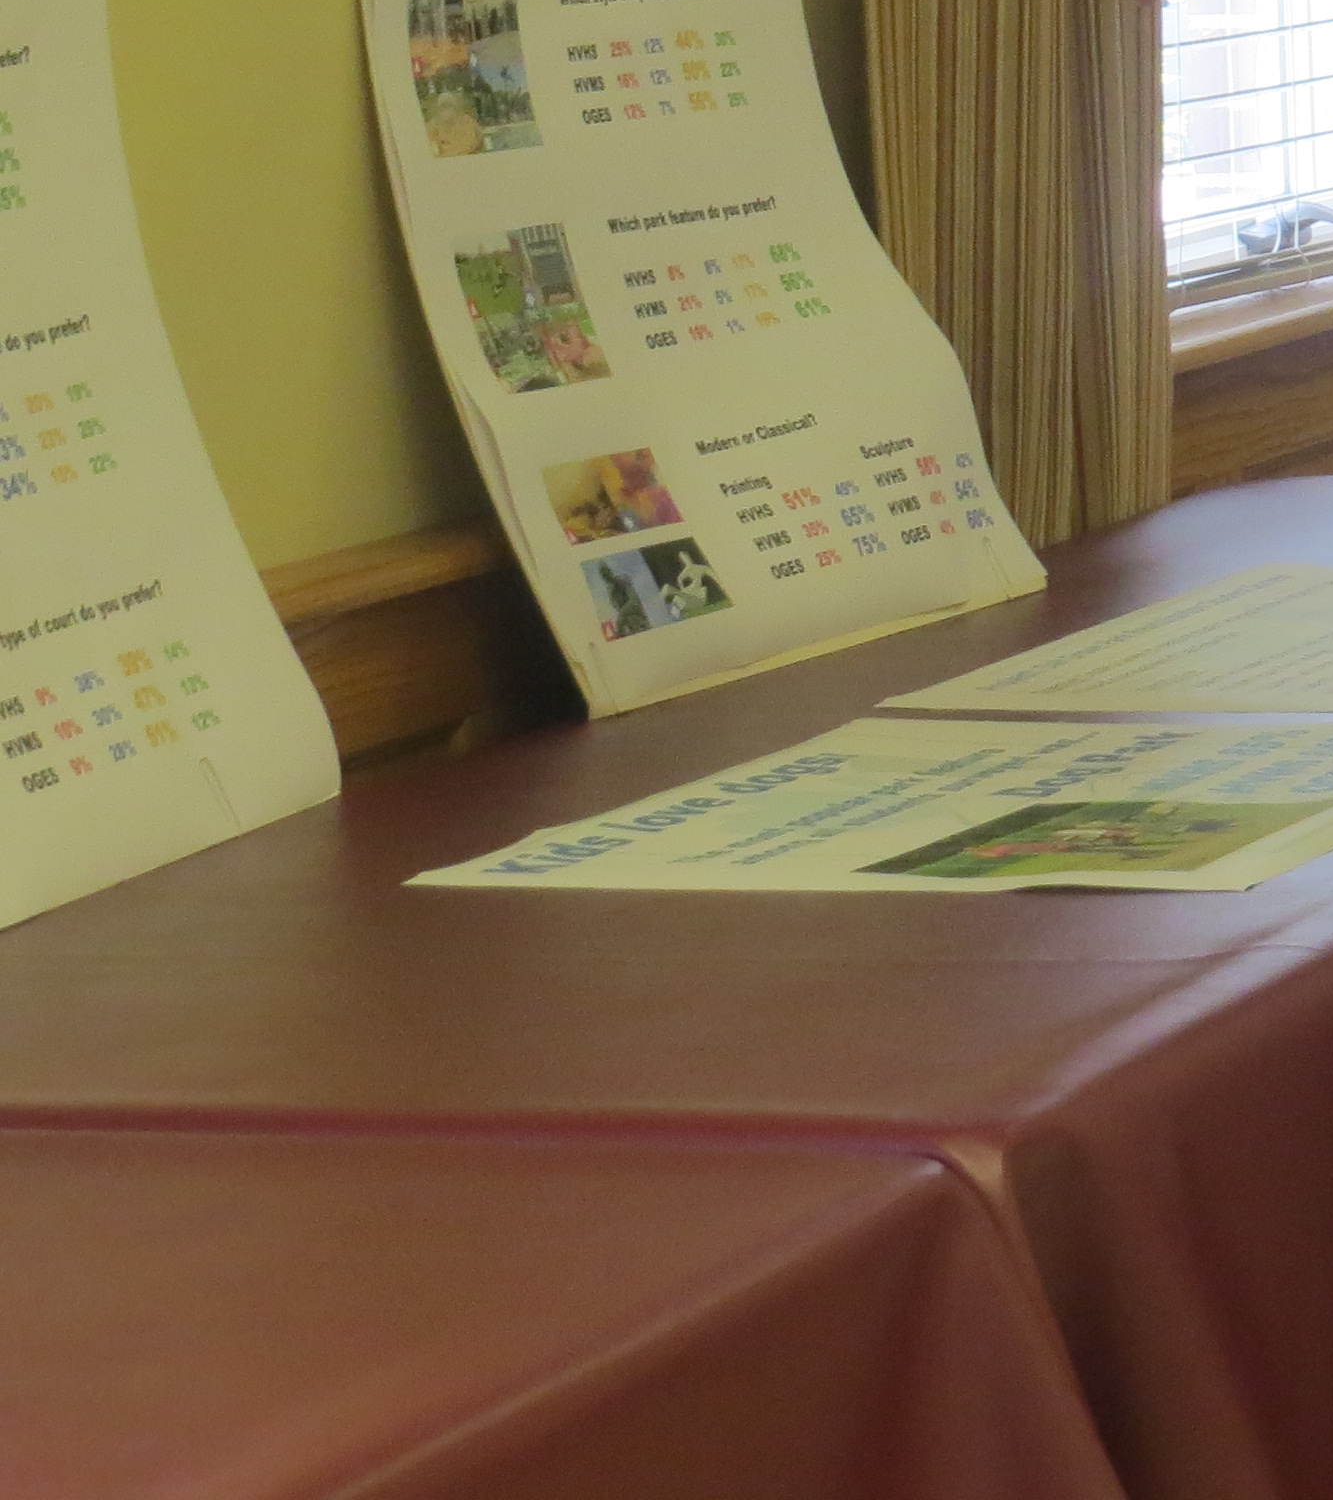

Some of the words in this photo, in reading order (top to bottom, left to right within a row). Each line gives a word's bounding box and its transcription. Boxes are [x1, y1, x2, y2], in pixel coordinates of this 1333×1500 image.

[566, 43, 598, 62] HVHS
[573, 75, 606, 93] HVMS
[581, 106, 614, 125] OGES
[606, 215, 643, 234] Which
[643, 214, 668, 232] park
[668, 207, 707, 227] feature
[707, 204, 721, 220] do
[722, 203, 741, 221] you
[742, 195, 777, 217] prefer?
[623, 269, 657, 288] HVHS
[633, 300, 668, 320] HVMS
[5, 333, 21, 351] do
[22, 329, 47, 351] you
[48, 313, 91, 345] prefer?
[645, 329, 679, 350] OGES
[694, 434, 739, 457] Modern
[741, 430, 756, 446] or
[755, 412, 819, 442] Classical?
[859, 436, 914, 460] Sculpture
[719, 473, 774, 498] Painting
[873, 467, 909, 488] HVHS
[736, 502, 774, 525] HVHS
[779, 486, 822, 511] 51%
[887, 494, 922, 517] HVMS
[753, 529, 792, 553] HVMS
[839, 503, 876, 528] 65%
[900, 524, 932, 545] OGES
[769, 557, 805, 580] OGES
[851, 531, 888, 556] 75%
[28, 618, 42, 639] of
[44, 608, 76, 634] court
[79, 603, 96, 623] do
[97, 598, 121, 620] you
[121, 578, 163, 612] prefer?
[2, 730, 44, 759] HVMS
[991, 765, 1128, 798] Dog
[1074, 730, 1201, 763] Park
[21, 766, 60, 794] OGES
[482, 834, 635, 874] Kids
[597, 796, 737, 834] love
